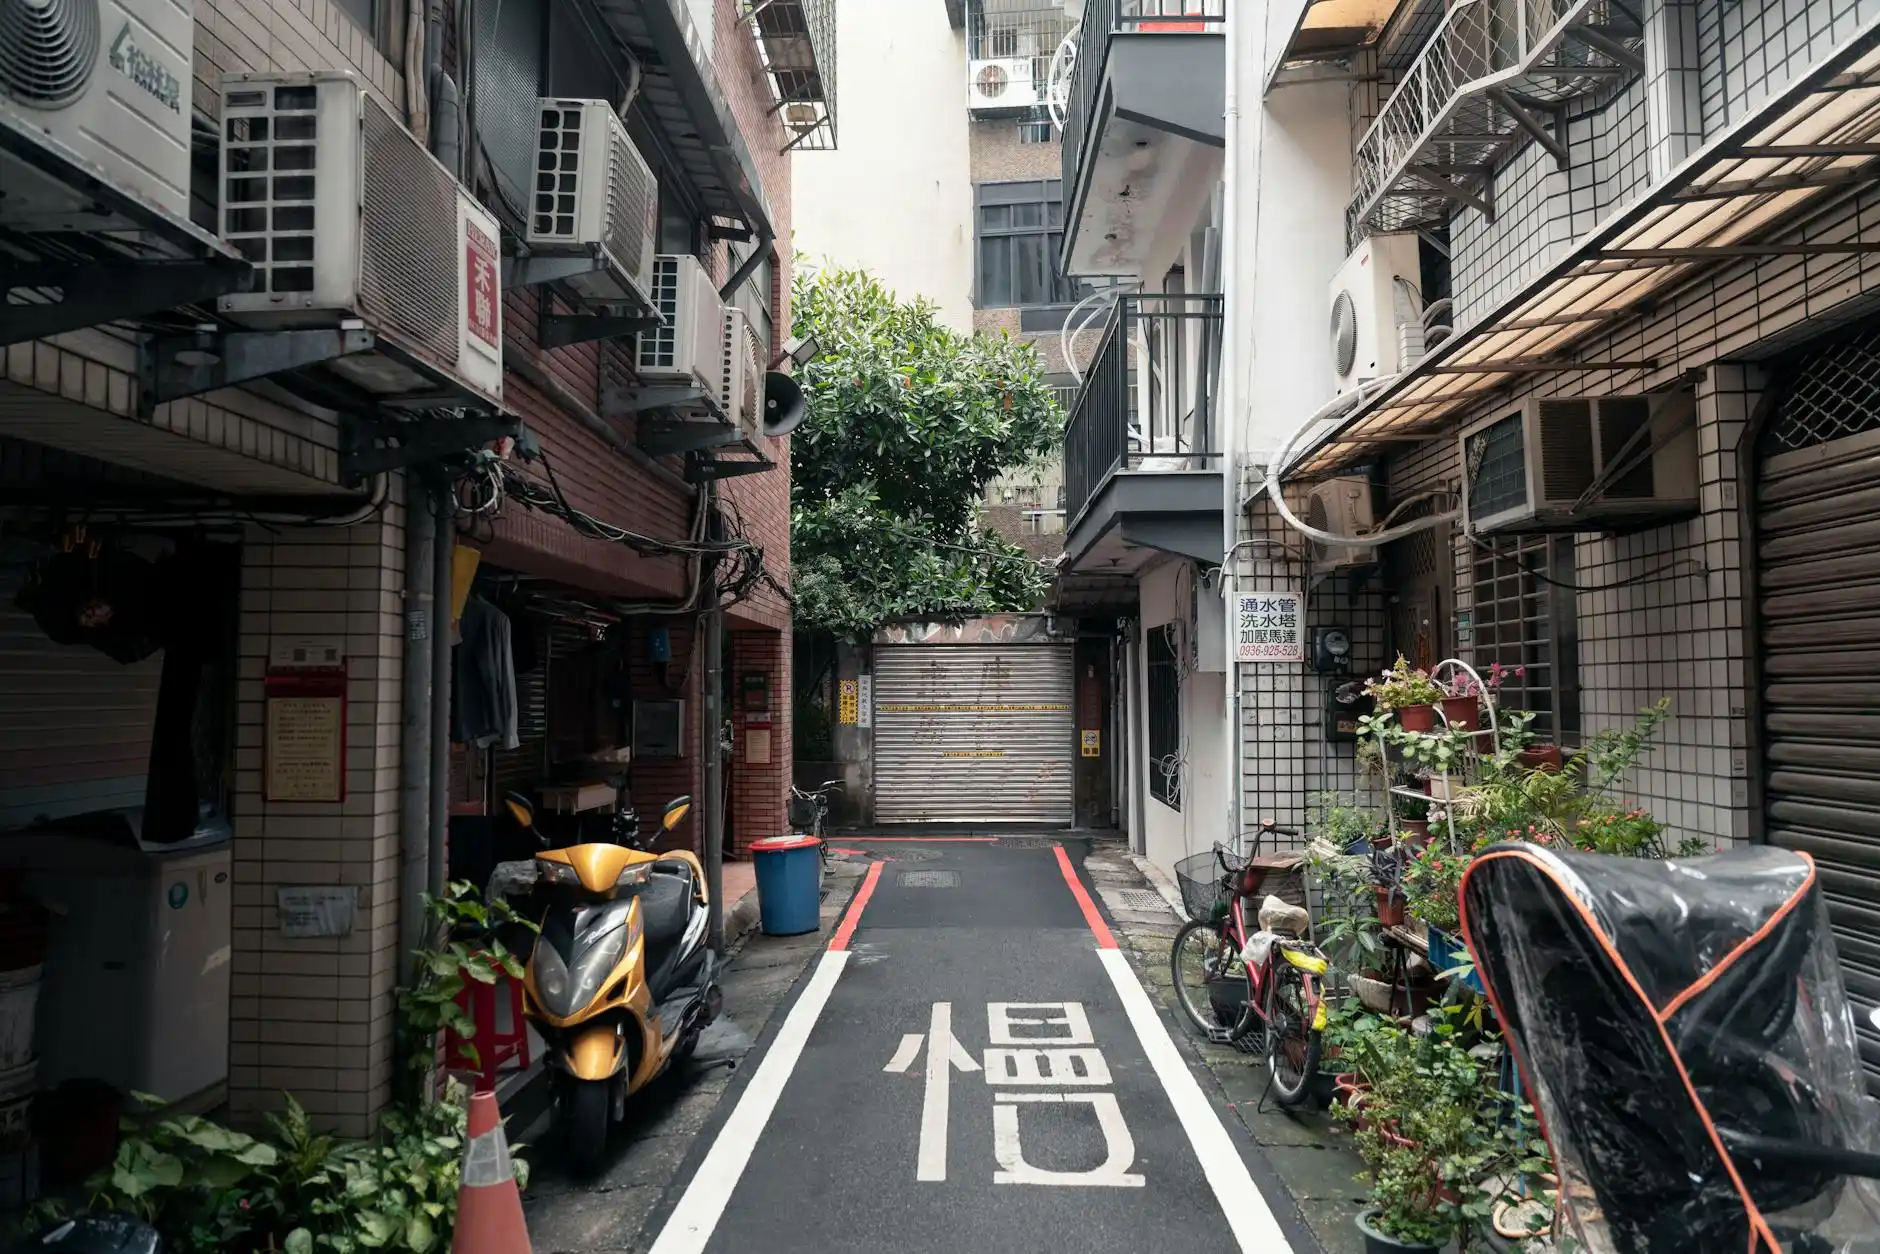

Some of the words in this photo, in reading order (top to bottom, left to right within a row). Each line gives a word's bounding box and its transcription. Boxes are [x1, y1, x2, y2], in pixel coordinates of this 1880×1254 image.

[474, 255, 492, 329] 禾聯
[1240, 598, 1296, 612] 通水管
[1240, 614, 1296, 628] 洗水塔
[1240, 630, 1296, 644] 加壓馬達
[1240, 645, 1298, 656] 0936-925-528
[882, 1002, 1146, 1187] 慢
